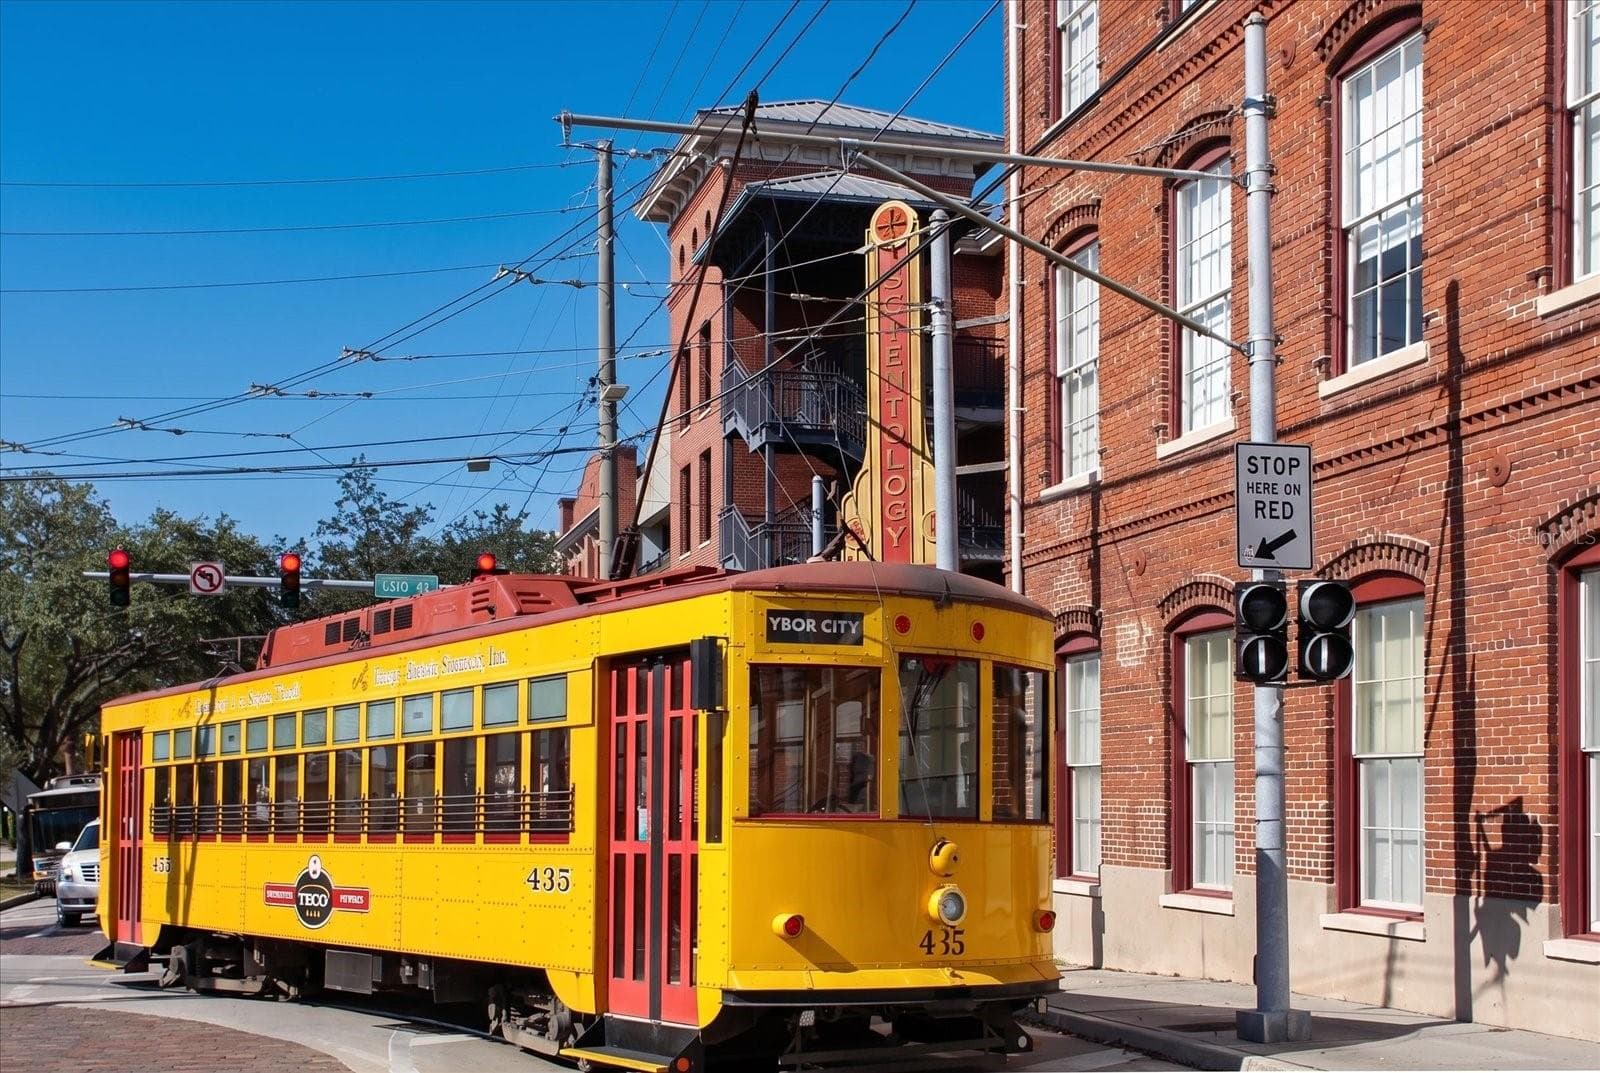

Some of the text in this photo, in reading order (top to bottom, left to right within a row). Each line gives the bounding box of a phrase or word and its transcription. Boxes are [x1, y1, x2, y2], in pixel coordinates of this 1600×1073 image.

[883, 268, 907, 548] SCIENTOLOGY
[1247, 455, 1300, 476] STOP
[1246, 482, 1301, 496] HERE ON
[1254, 500, 1294, 520] RED
[769, 617, 859, 634] YBOR CITY
[527, 867, 570, 892] 435
[298, 892, 329, 907] TECO
[919, 927, 965, 955] 435
